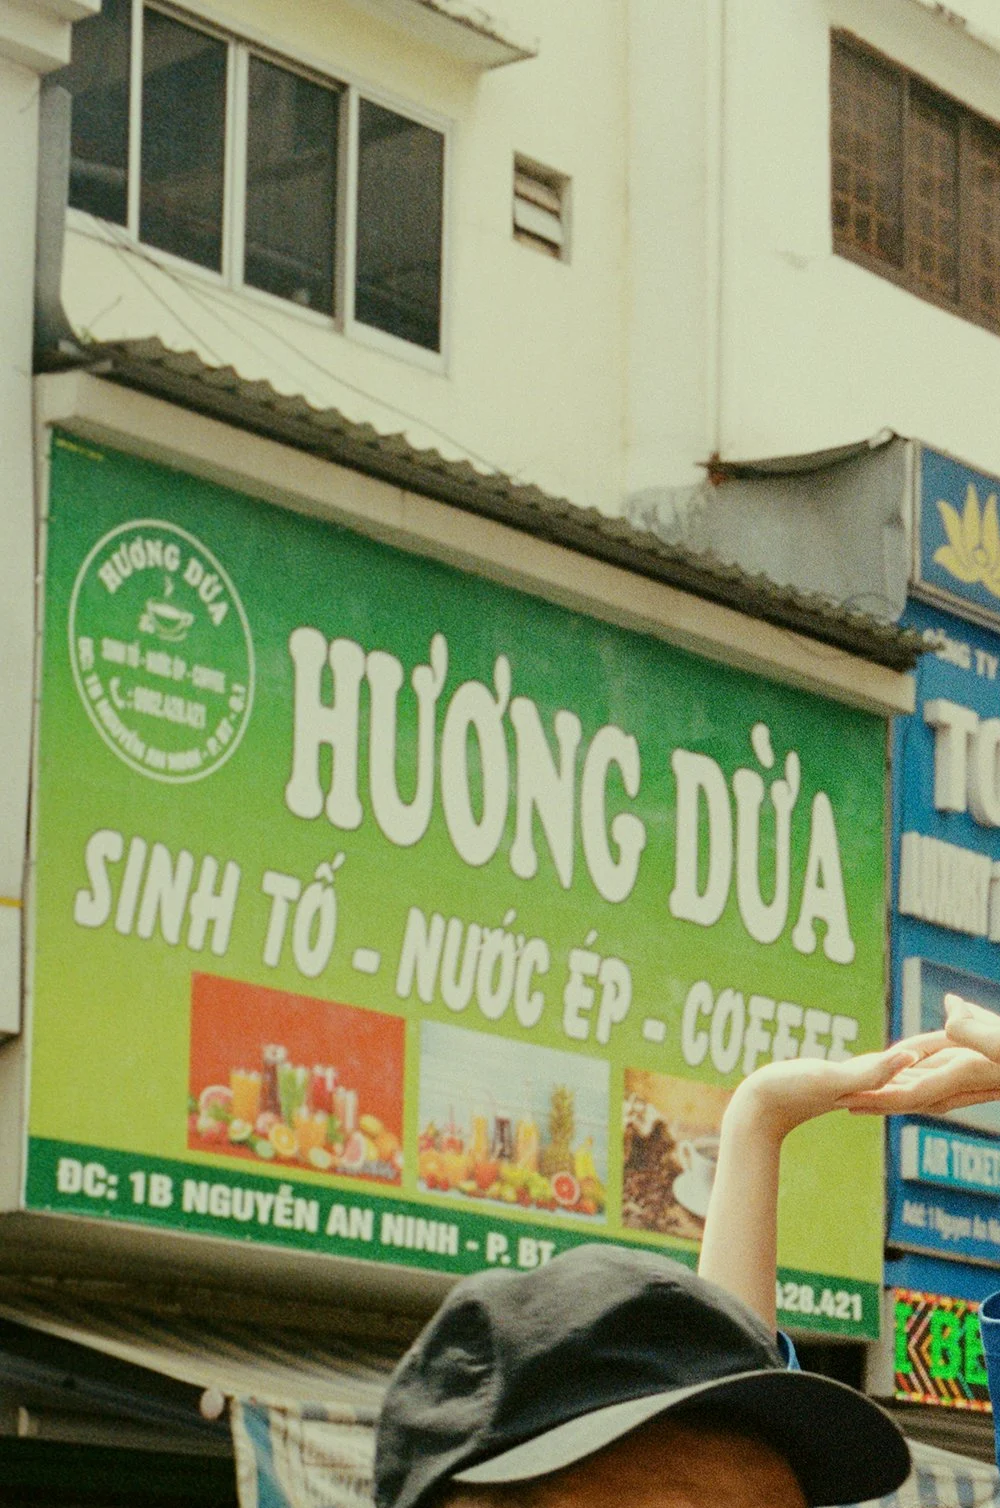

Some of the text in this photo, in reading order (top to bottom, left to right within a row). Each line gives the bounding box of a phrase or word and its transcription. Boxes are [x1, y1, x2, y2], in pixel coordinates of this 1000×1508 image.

[285, 626, 646, 902] HƯƠNG
[669, 723, 856, 965] DỪA
[73, 829, 242, 955] SINH
[262, 852, 346, 977] TỐ
[353, 949, 381, 976] -
[396, 907, 550, 1029] NƯỚC
[562, 929, 632, 1044] ÉP
[643, 1018, 666, 1043] -
[57, 1157, 118, 1199] ĐC:
[129, 1170, 174, 1208] 1B
[183, 1176, 320, 1232] NGUYỄN
[325, 1199, 374, 1241] AN
[381, 1209, 459, 1256] NINH
[485, 1231, 511, 1264] P.
[518, 1237, 556, 1267] BT
